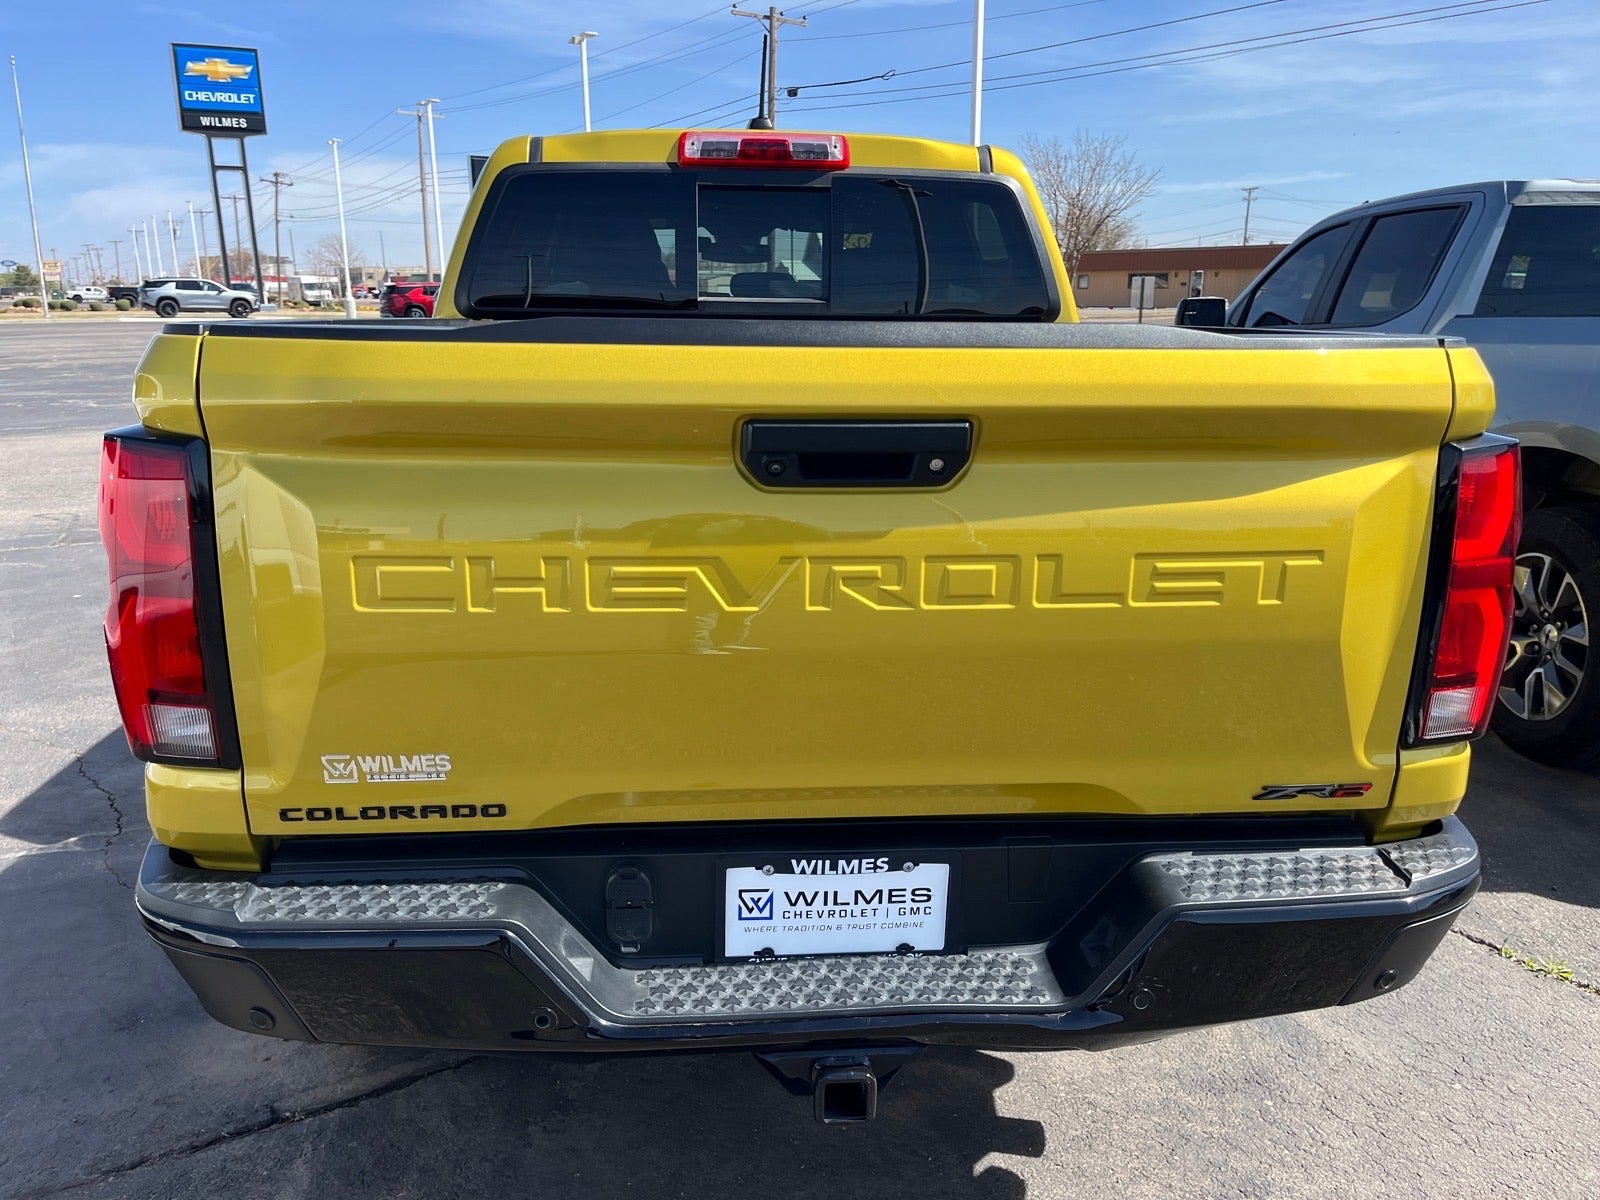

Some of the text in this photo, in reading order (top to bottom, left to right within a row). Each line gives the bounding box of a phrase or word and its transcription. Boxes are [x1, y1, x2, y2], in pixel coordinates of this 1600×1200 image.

[184, 90, 256, 104] CHEVROLET
[200, 116, 248, 128] WILMES
[350, 549, 1325, 614] CHEVROLET
[357, 753, 452, 773] WILMES
[1251, 782, 1374, 801] ZR2
[279, 803, 507, 822] COLORADO
[791, 857, 889, 875] WILMES
[783, 887, 932, 907] WILMES
[782, 908, 879, 920] CHEVROLET
[898, 906, 932, 916] GMC
[744, 925, 778, 933] WHERE
[782, 924, 833, 932] TRADITION
[880, 921, 925, 929] COMBINE
